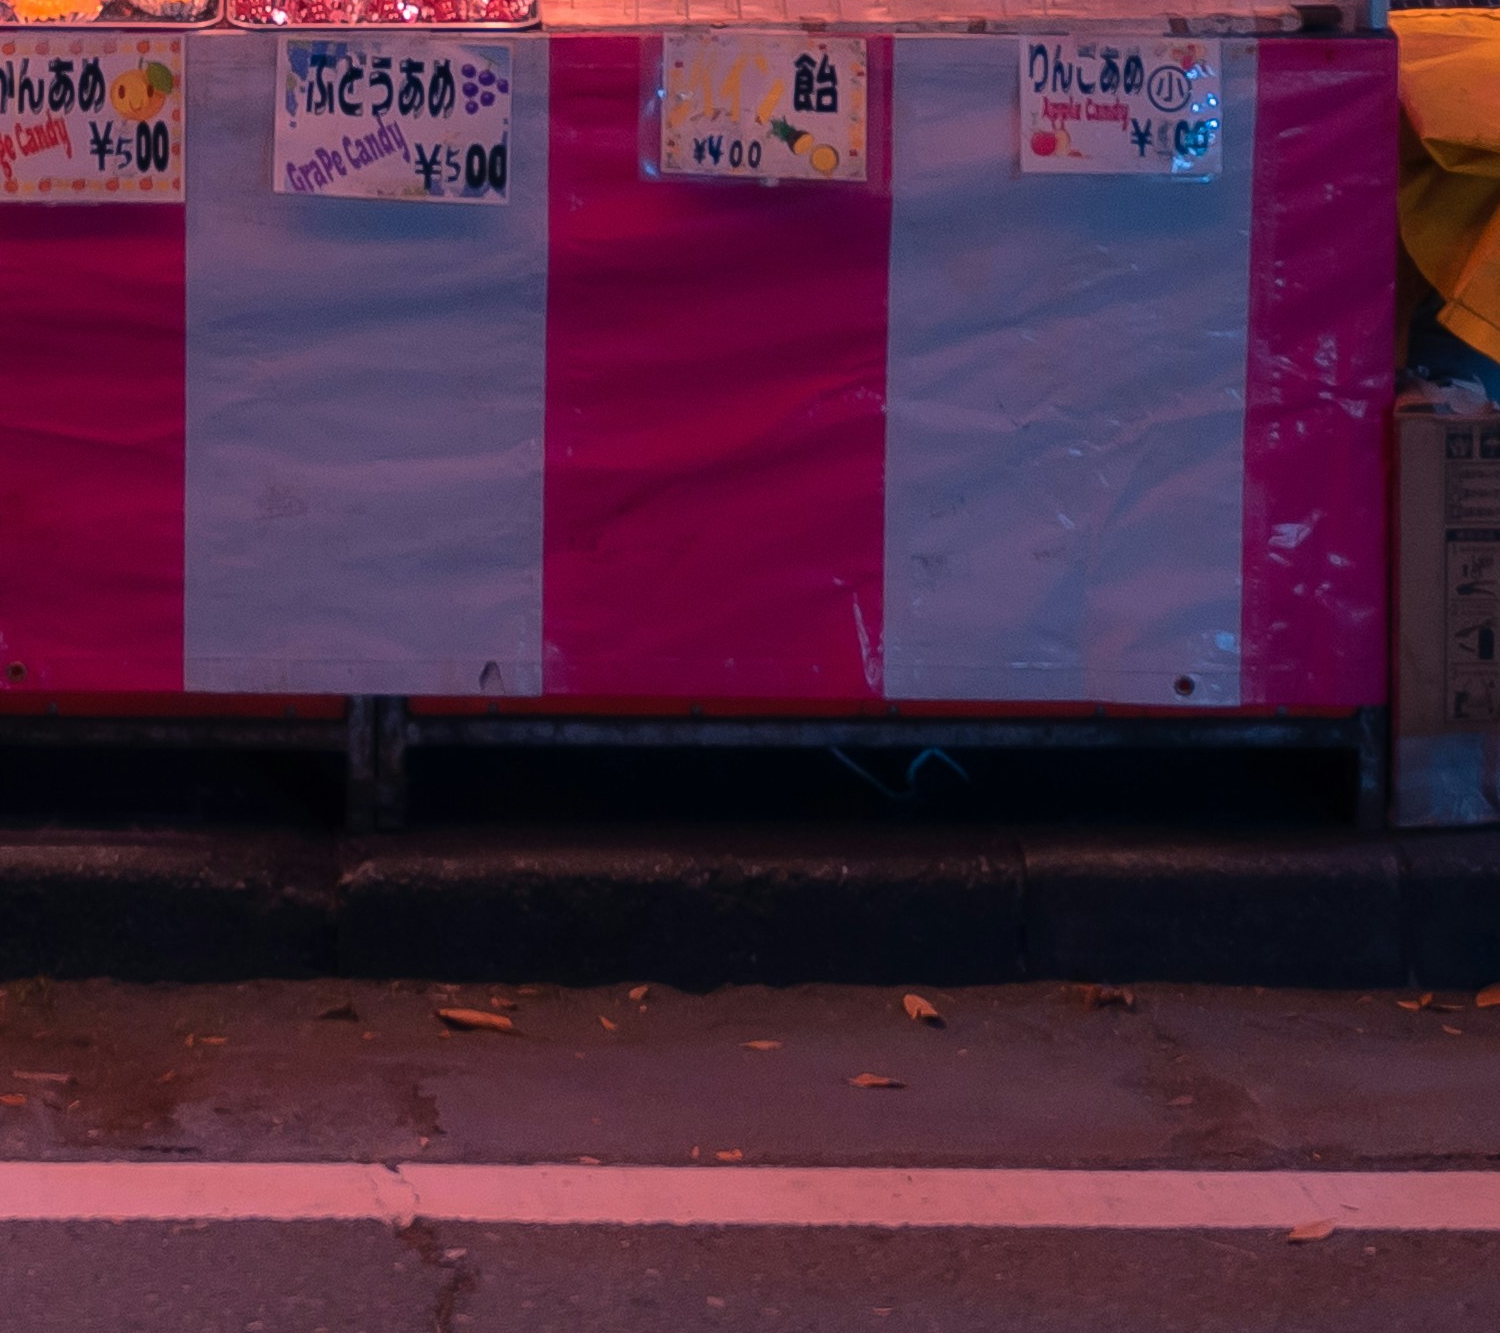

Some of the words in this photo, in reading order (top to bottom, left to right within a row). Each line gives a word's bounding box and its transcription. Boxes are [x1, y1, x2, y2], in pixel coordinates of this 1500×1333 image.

[306, 54, 456, 119] ぶどうあめ
[1028, 43, 1145, 95] りんごあめ
[13, 109, 73, 159] Candy
[88, 120, 169, 172] ¥500
[341, 111, 412, 170] Candy
[414, 143, 508, 190] ¥500
